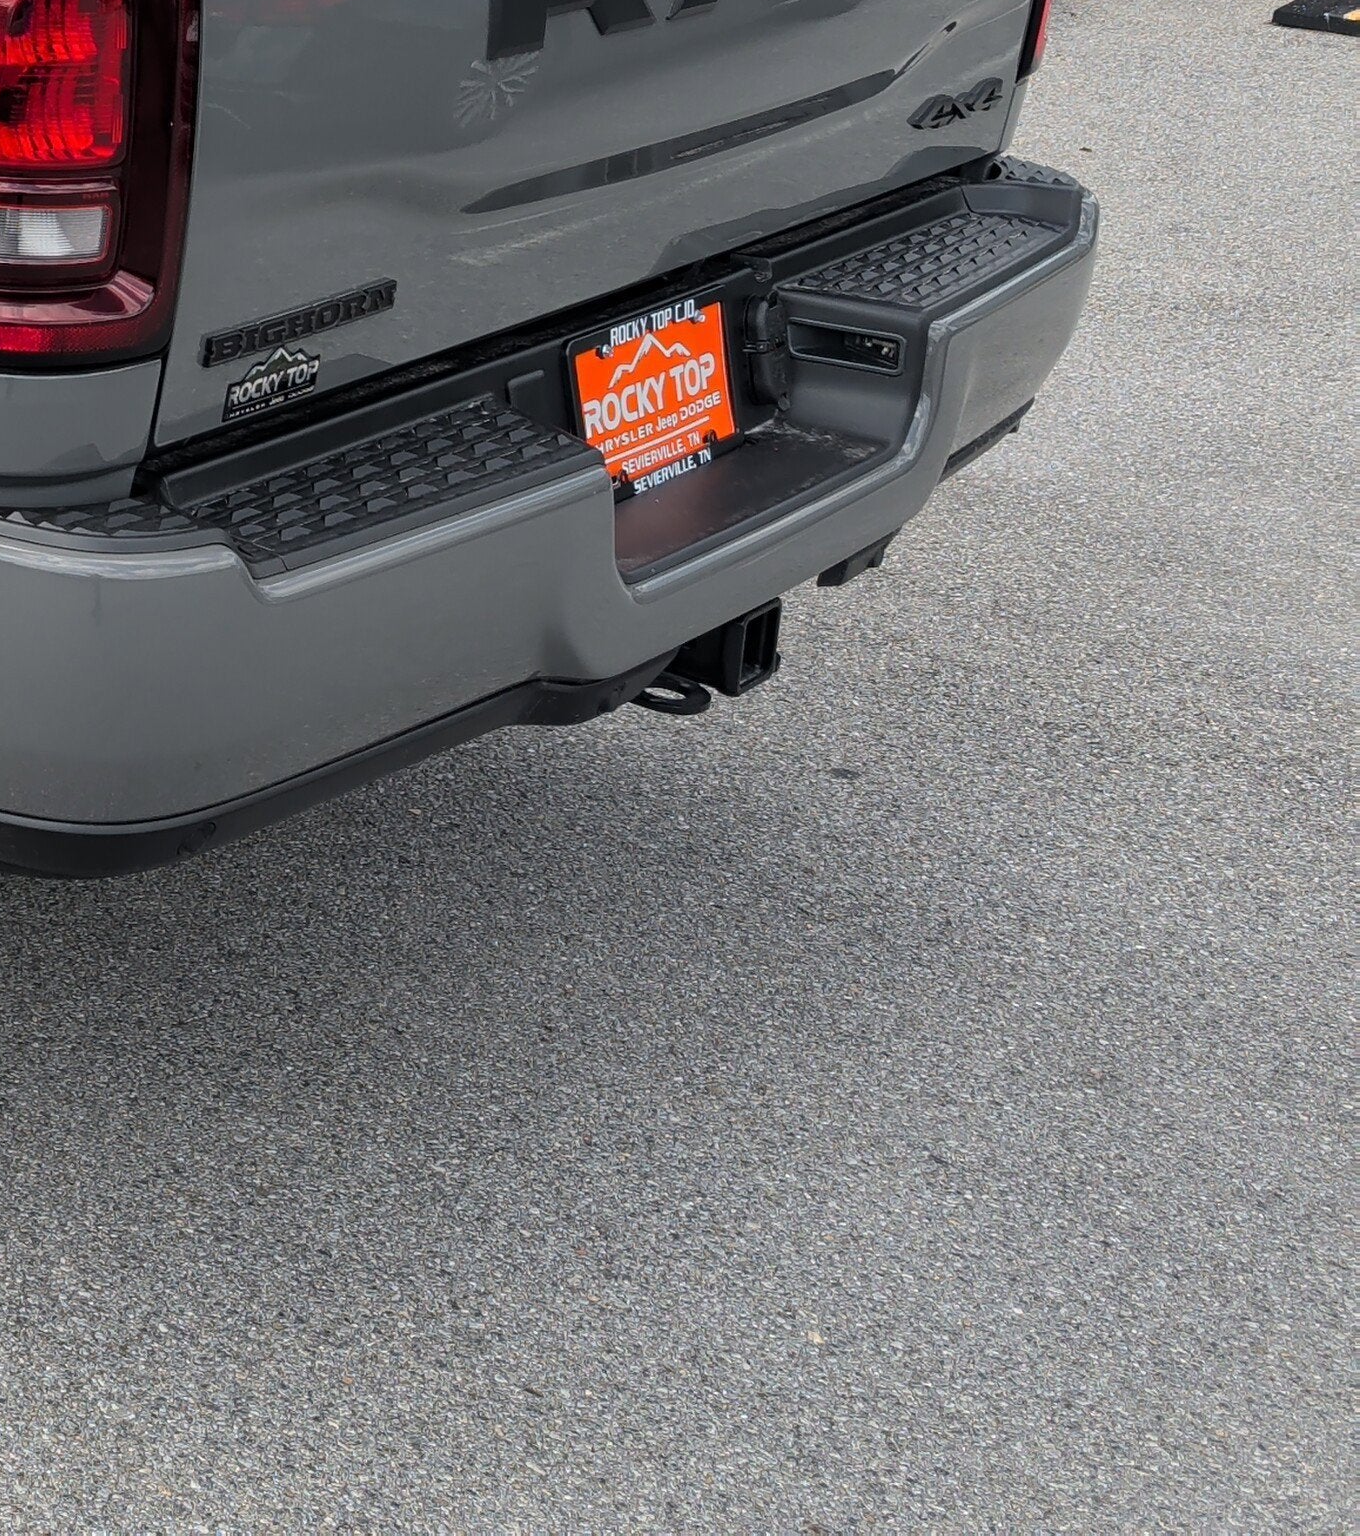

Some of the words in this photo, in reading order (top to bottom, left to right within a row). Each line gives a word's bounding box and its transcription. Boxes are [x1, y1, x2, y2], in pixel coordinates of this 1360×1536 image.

[610, 316, 650, 348] ROCKY
[651, 305, 673, 334] TOP
[228, 371, 285, 408] ROCKY
[287, 359, 320, 387] TOP
[583, 372, 666, 440] ROCKY
[669, 352, 716, 403] TOP
[595, 421, 654, 455] HRYSLER
[656, 413, 678, 433] Jeep
[680, 390, 722, 421] DODGE
[698, 447, 712, 466] TN
